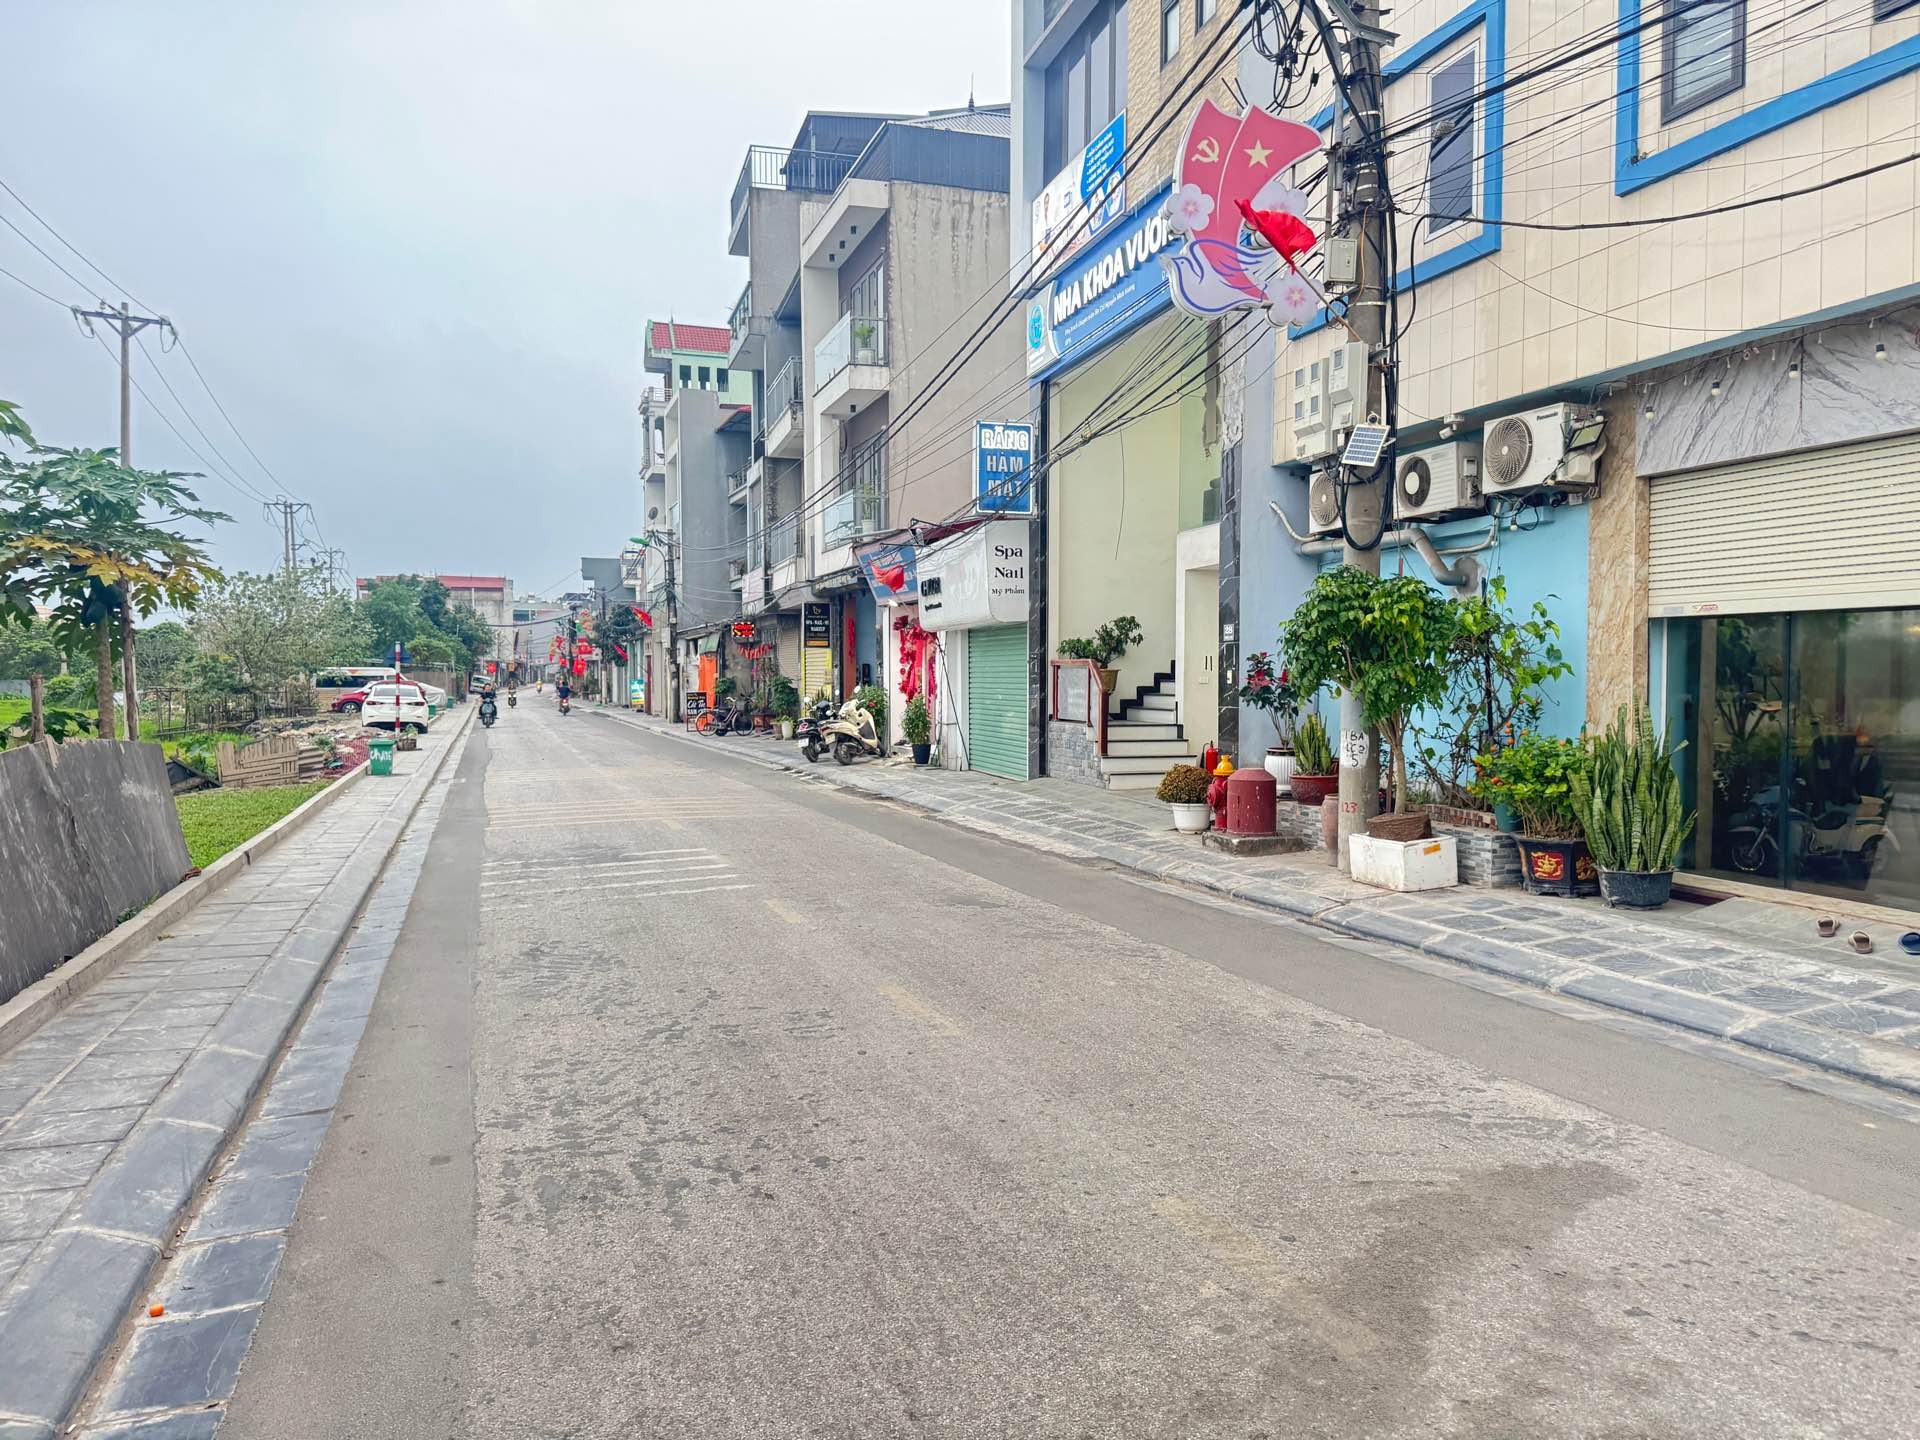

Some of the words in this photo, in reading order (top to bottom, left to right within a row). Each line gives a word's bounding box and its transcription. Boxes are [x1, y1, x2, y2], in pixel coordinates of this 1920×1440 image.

[1053, 280, 1082, 326] NHA
[1083, 247, 1125, 304] KHOA
[981, 426, 1029, 450] RĂNG
[986, 452, 1023, 473] HÀM
[994, 545, 1023, 560] Spa
[994, 567, 1024, 579] Nail
[1351, 753, 1359, 768] 5
